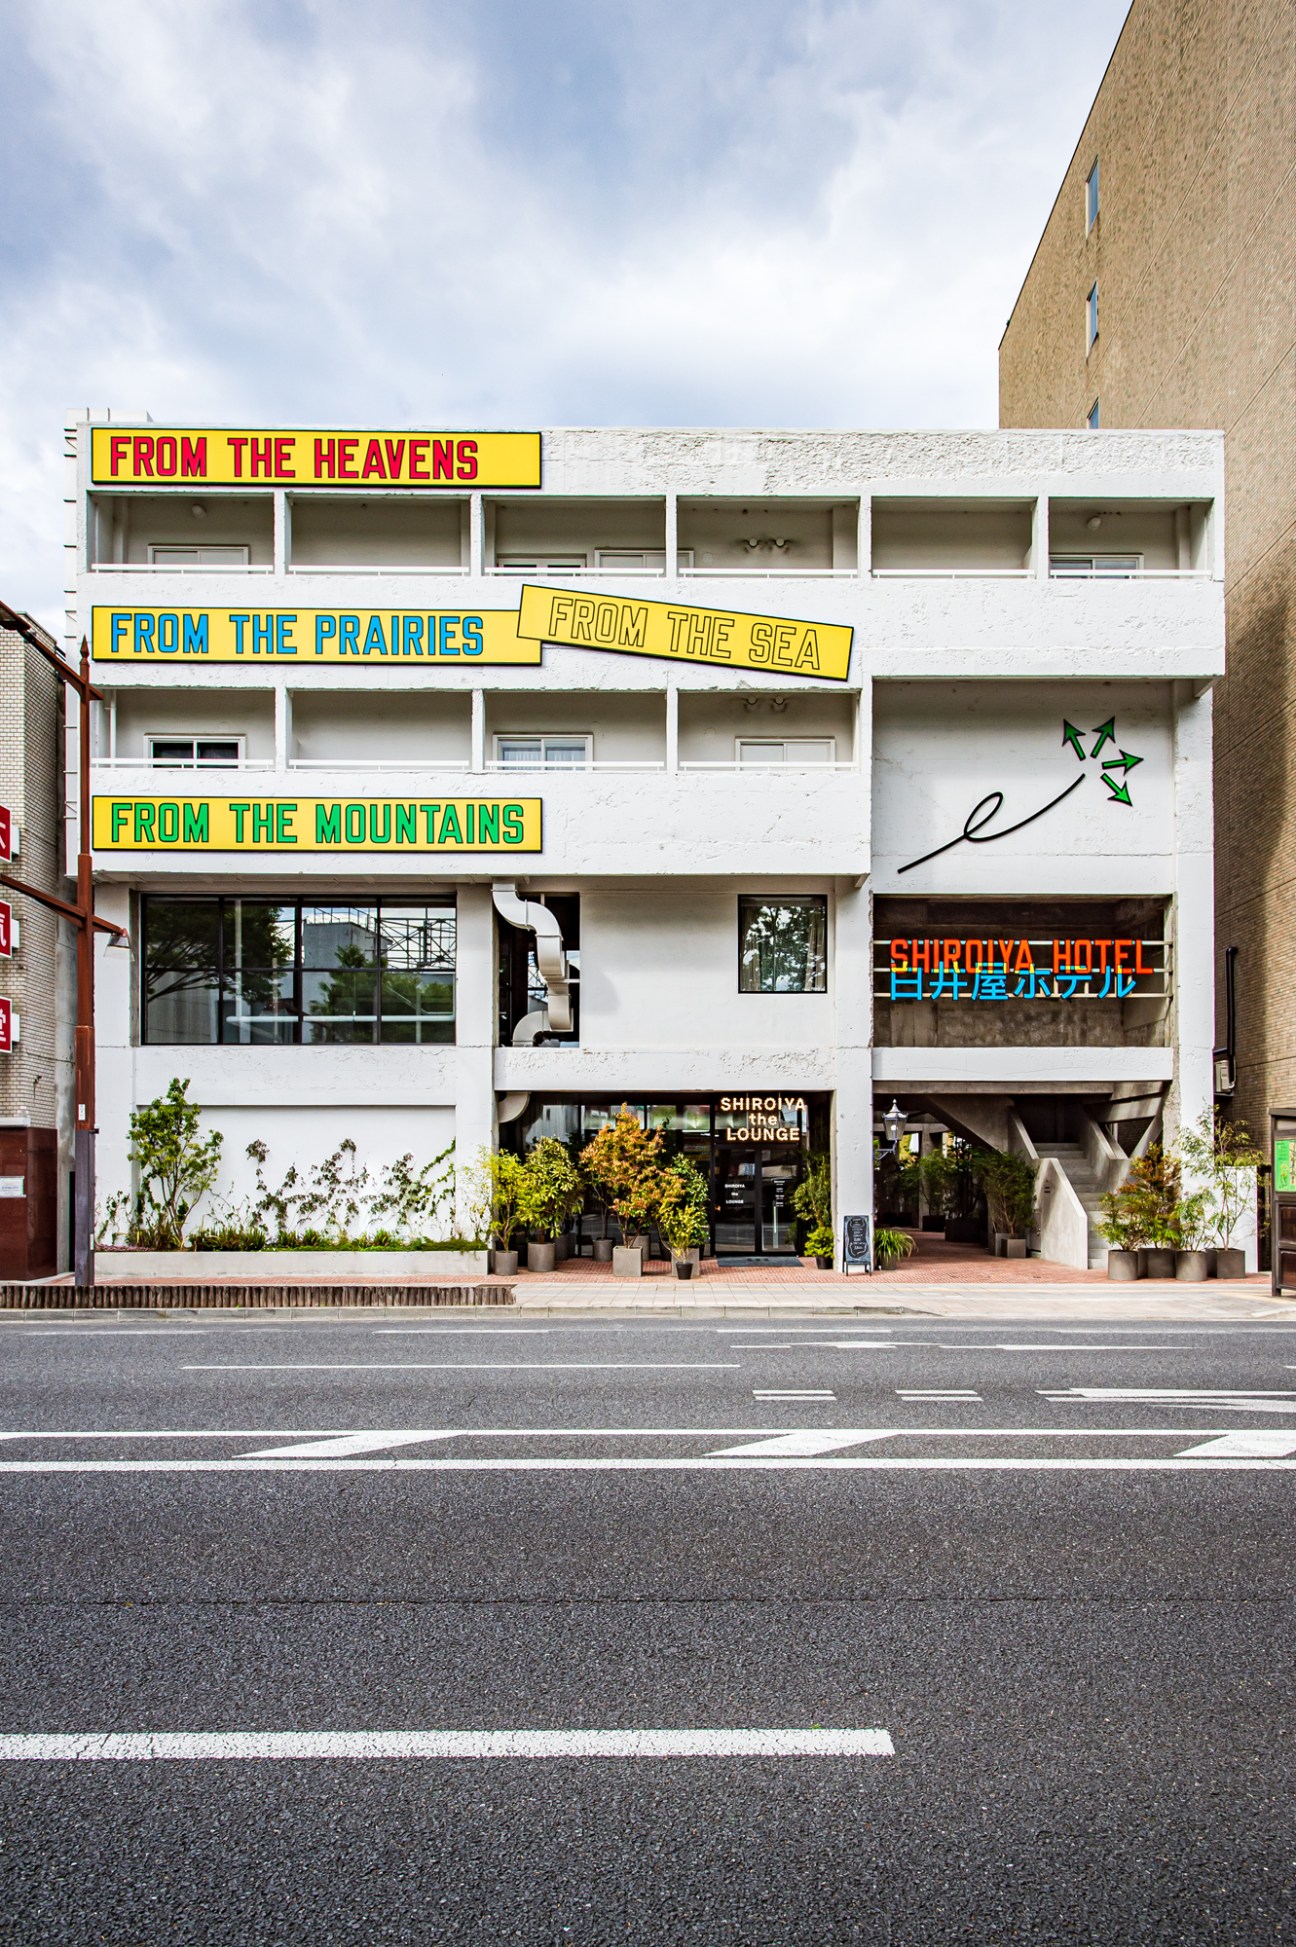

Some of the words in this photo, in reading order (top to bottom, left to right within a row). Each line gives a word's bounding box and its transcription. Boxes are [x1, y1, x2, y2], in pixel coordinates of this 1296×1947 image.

[109, 435, 208, 478] FROM
[226, 437, 296, 479] THE
[313, 437, 479, 481] HEAVENS
[110, 612, 210, 654] FROM
[227, 613, 298, 655] THE
[314, 613, 484, 657] PRAIRIES
[548, 596, 649, 648] FROM
[667, 611, 735, 659] THE
[748, 622, 820, 670] SEA
[110, 802, 210, 844] FROM
[228, 802, 298, 844] THE
[314, 802, 525, 845] MOUNTAINS
[890, 939, 1034, 974] SHIROIYA
[1052, 939, 1155, 975] HOTEL
[890, 961, 1137, 1001] 白井屋ホテル
[720, 1097, 806, 1111] SHIROIYA
[748, 1113, 778, 1126] the
[726, 1127, 801, 1141] LOUNGE
